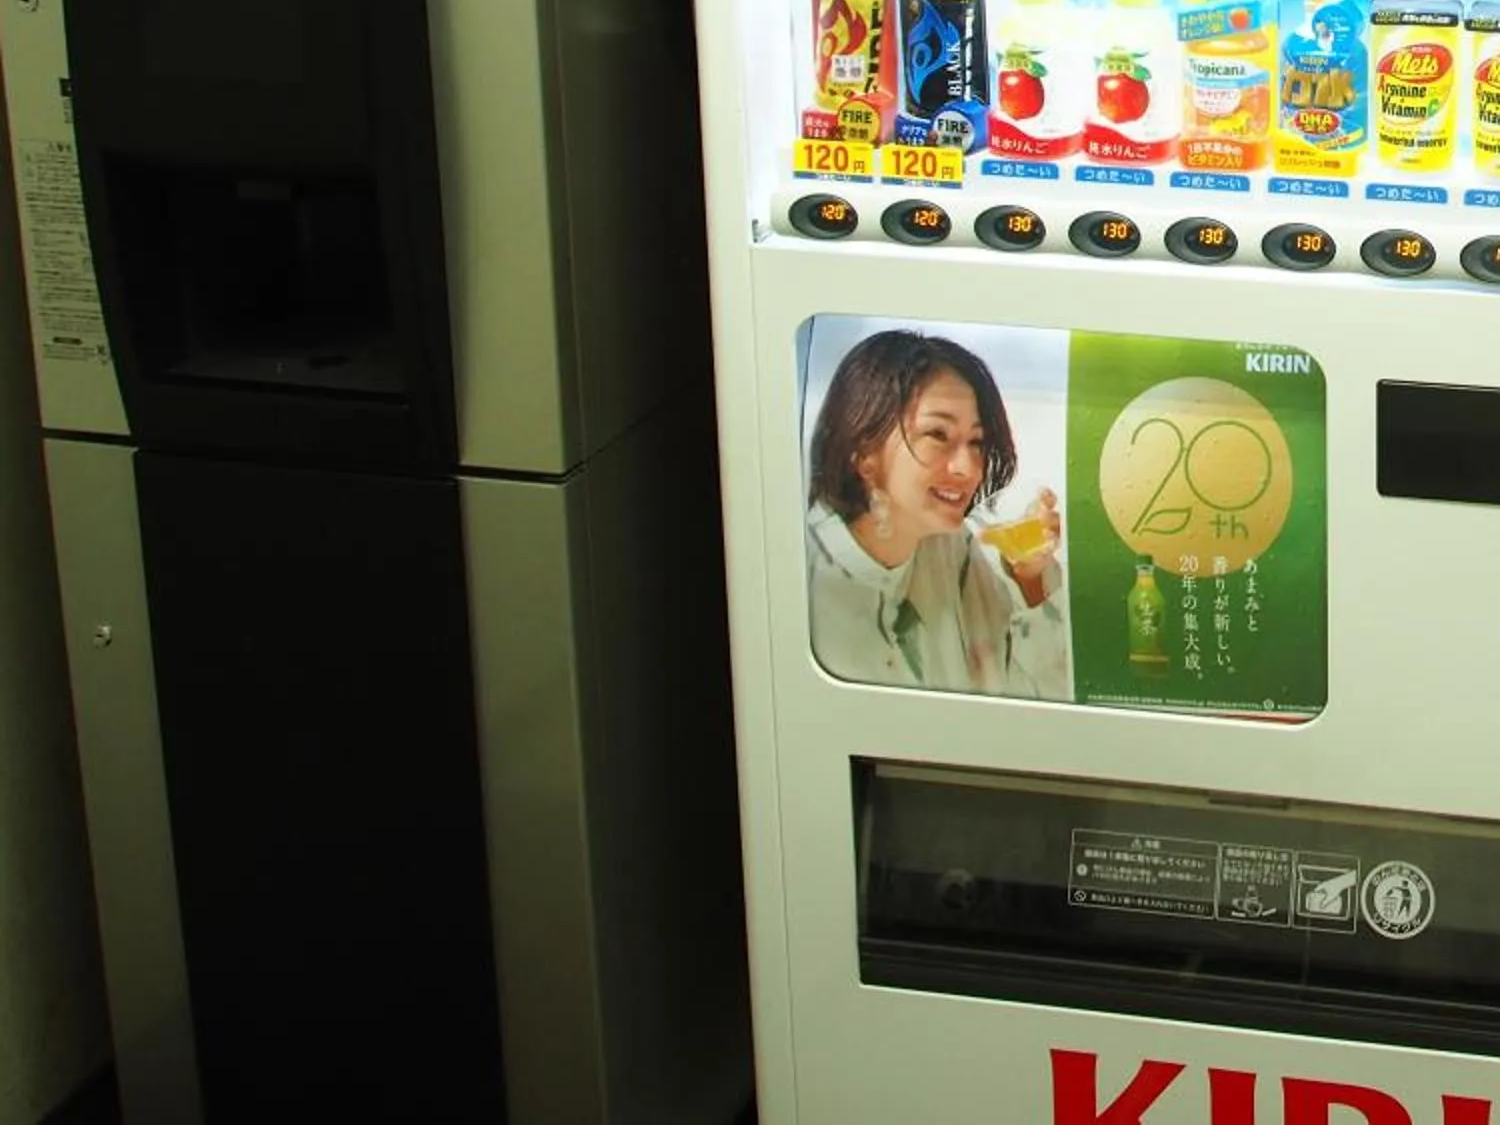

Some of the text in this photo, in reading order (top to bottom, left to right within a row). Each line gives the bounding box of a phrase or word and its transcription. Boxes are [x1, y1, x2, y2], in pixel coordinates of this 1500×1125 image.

[946, 39, 962, 96] BLACK
[1188, 58, 1246, 78] Tropicana
[1391, 50, 1439, 75] Mets
[842, 110, 873, 124] FIRE
[937, 119, 969, 134] FIRE
[821, 204, 846, 220] 120
[914, 210, 939, 226] 120
[1008, 216, 1031, 232] 130
[1103, 222, 1127, 238] 130
[1199, 227, 1223, 245] 130
[1297, 234, 1321, 251] 130
[1396, 240, 1421, 257] 130
[1245, 352, 1310, 374] KIRIN
[1243, 558, 1260, 633] あまみと
[1179, 554, 1204, 680] 20年の集大成。
[1212, 556, 1236, 674] 香りが新しい。
